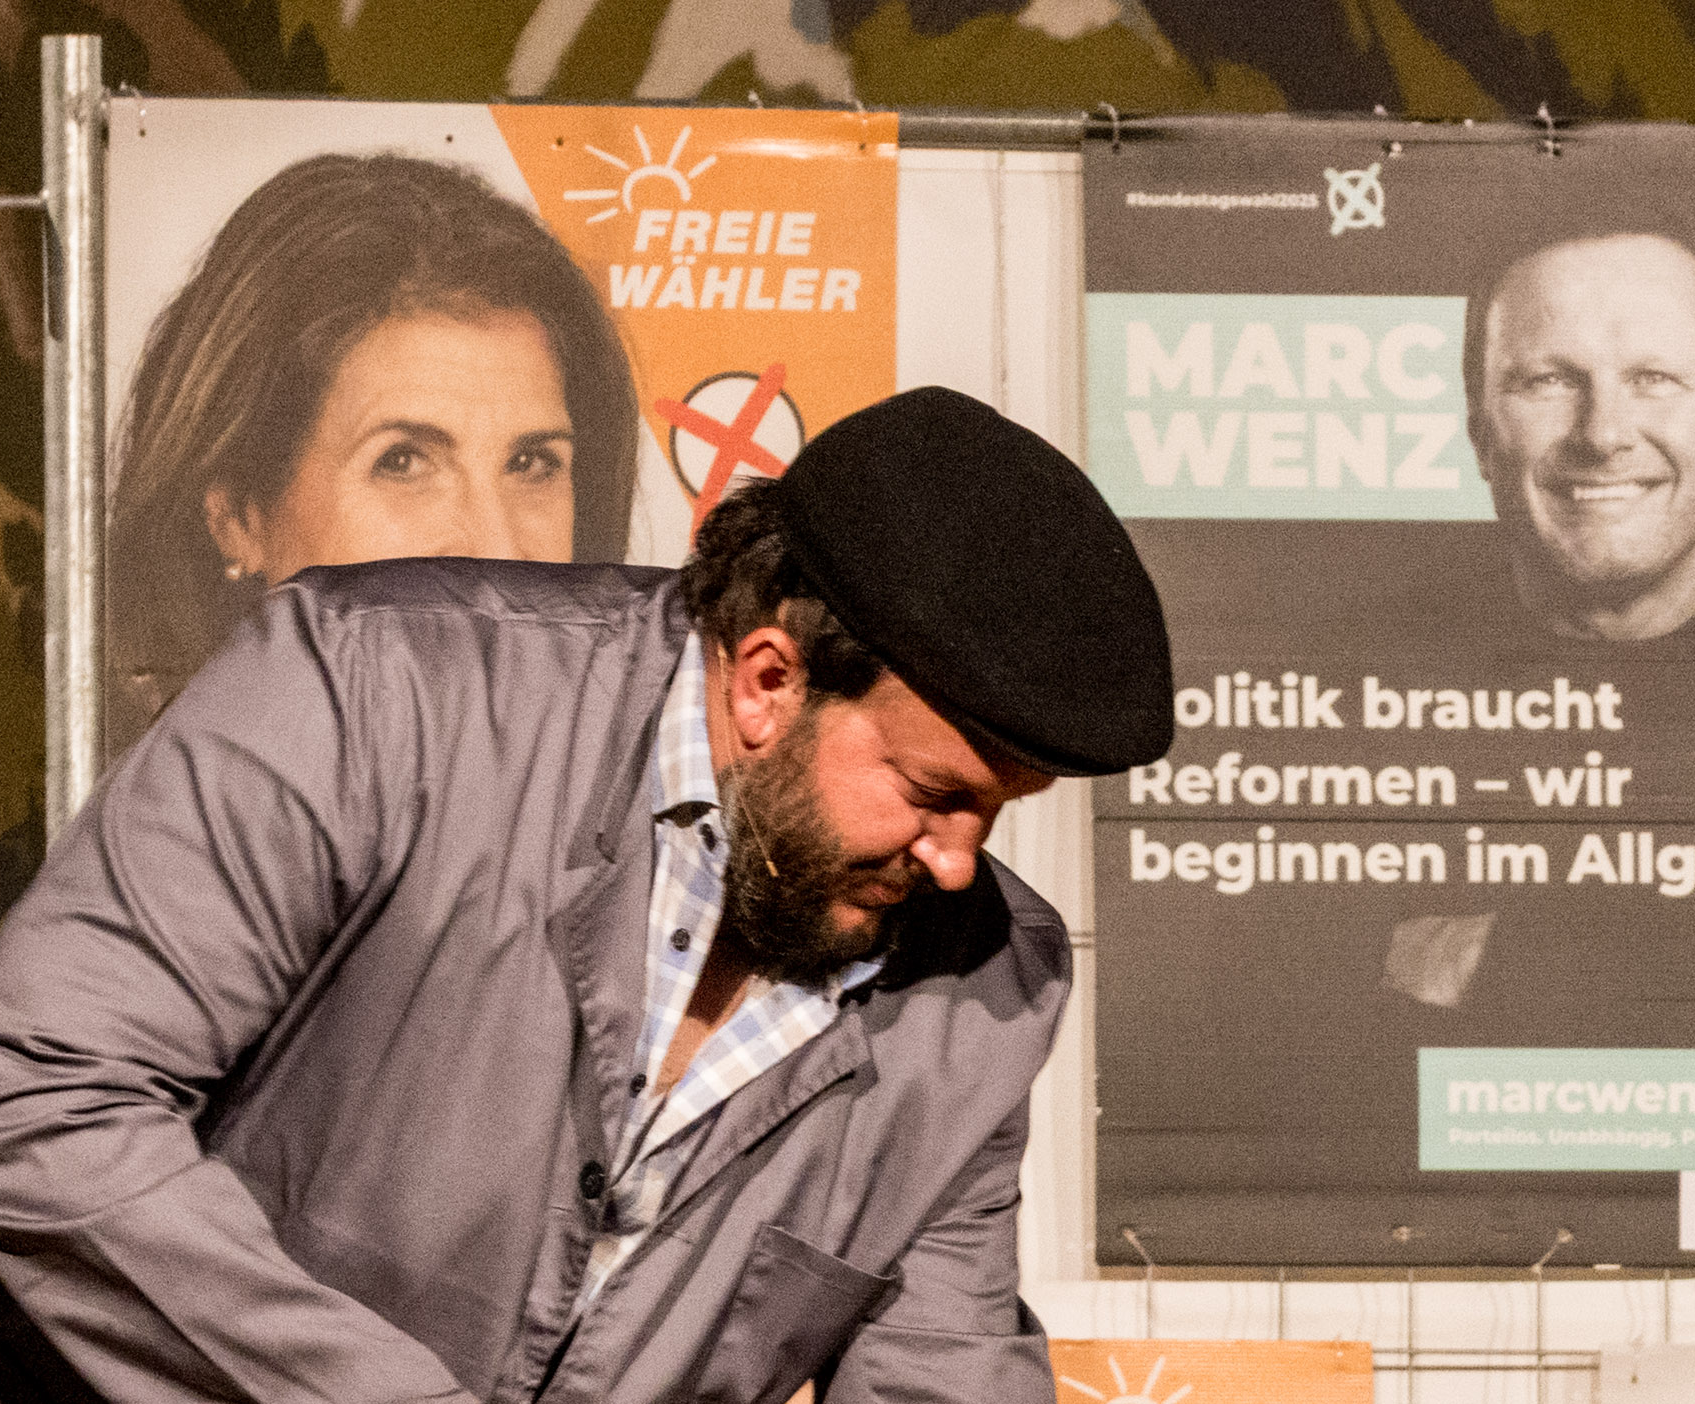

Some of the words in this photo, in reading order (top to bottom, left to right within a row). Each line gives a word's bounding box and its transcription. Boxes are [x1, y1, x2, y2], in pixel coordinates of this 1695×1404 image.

[633, 209, 819, 256] FREIE
[608, 256, 862, 312] WÄHLER
[1124, 320, 1446, 400] MARC
[1124, 410, 1461, 490] WENZ
[1173, 671, 1344, 730] olitik
[1362, 675, 1624, 732] braucht
[1128, 751, 1457, 807] Reformen
[1523, 750, 1634, 808] wir
[1128, 825, 1447, 894] beginnen
[1465, 825, 1550, 884] im
